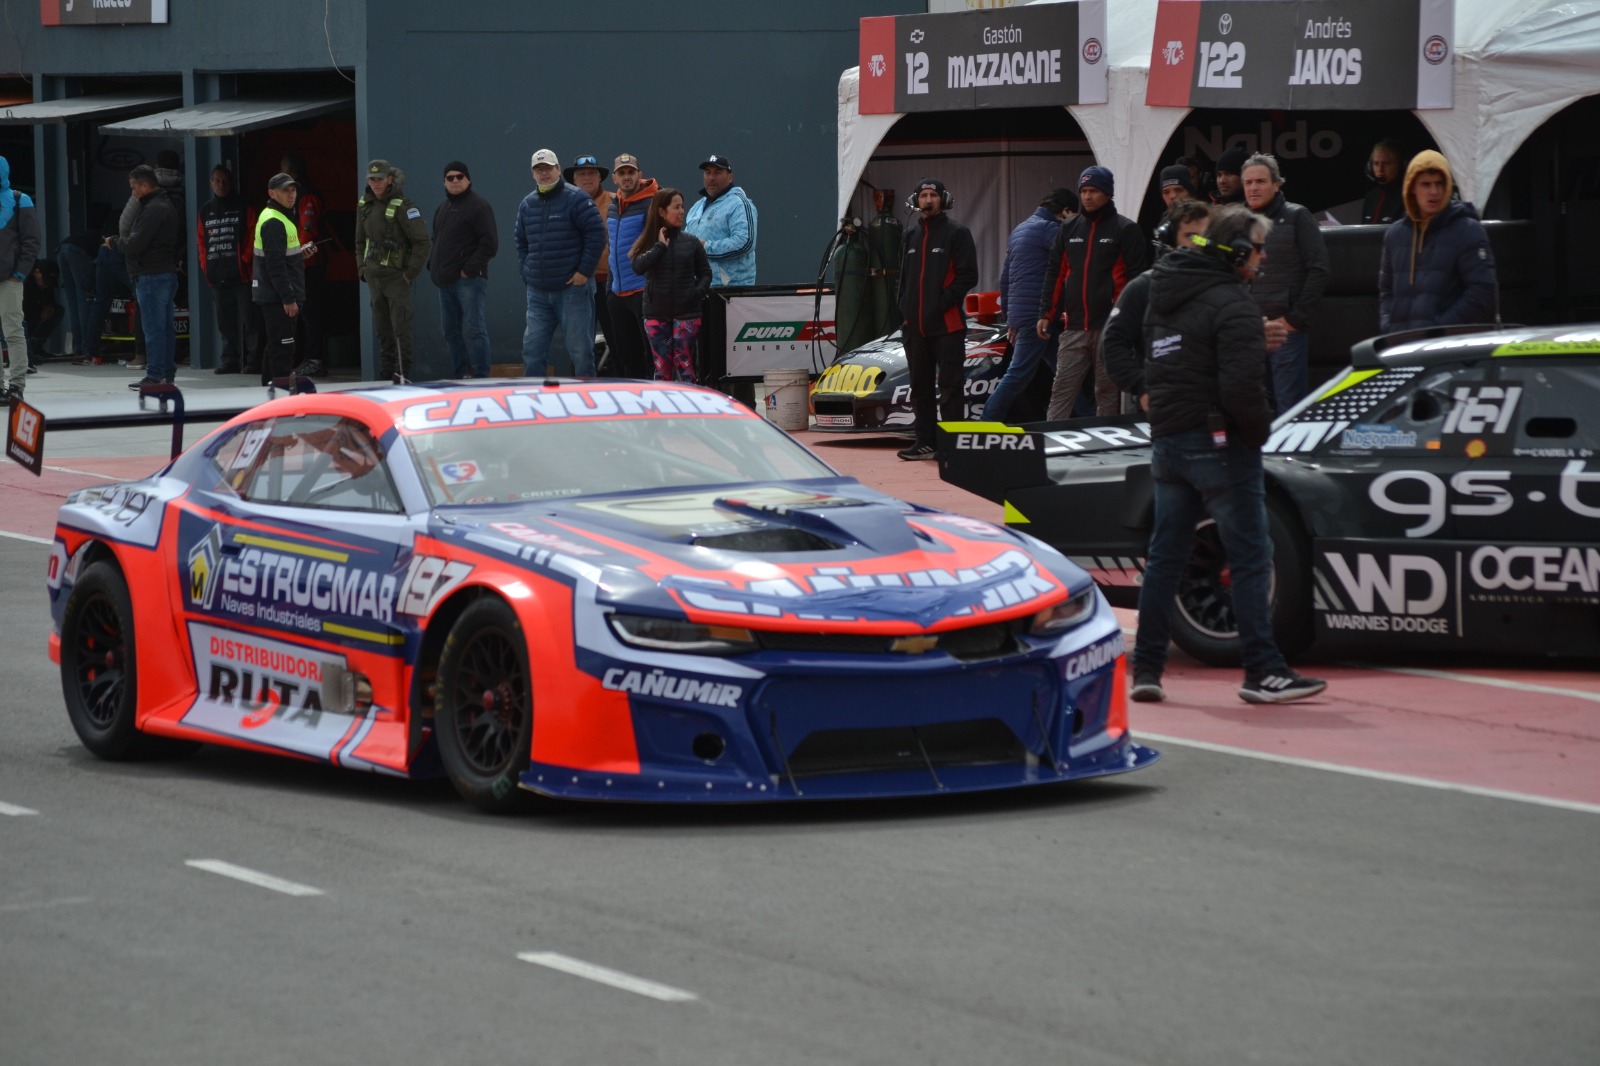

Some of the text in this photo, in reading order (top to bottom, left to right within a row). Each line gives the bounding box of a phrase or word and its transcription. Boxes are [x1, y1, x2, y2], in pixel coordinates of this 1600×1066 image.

[983, 24, 1022, 46] Gastón
[1304, 17, 1352, 39] Andrés
[905, 51, 930, 95] 12
[947, 49, 1062, 89] MAZZACANE
[1198, 41, 1246, 88] 122
[1289, 47, 1362, 86] JAKOS
[742, 326, 796, 339] PUMA
[1441, 386, 1523, 434] 161
[956, 434, 1036, 450] ELPRA
[396, 554, 475, 616] 197
[221, 593, 321, 632] Naves Industriales
[1326, 614, 1449, 633] WARNES DODGE
